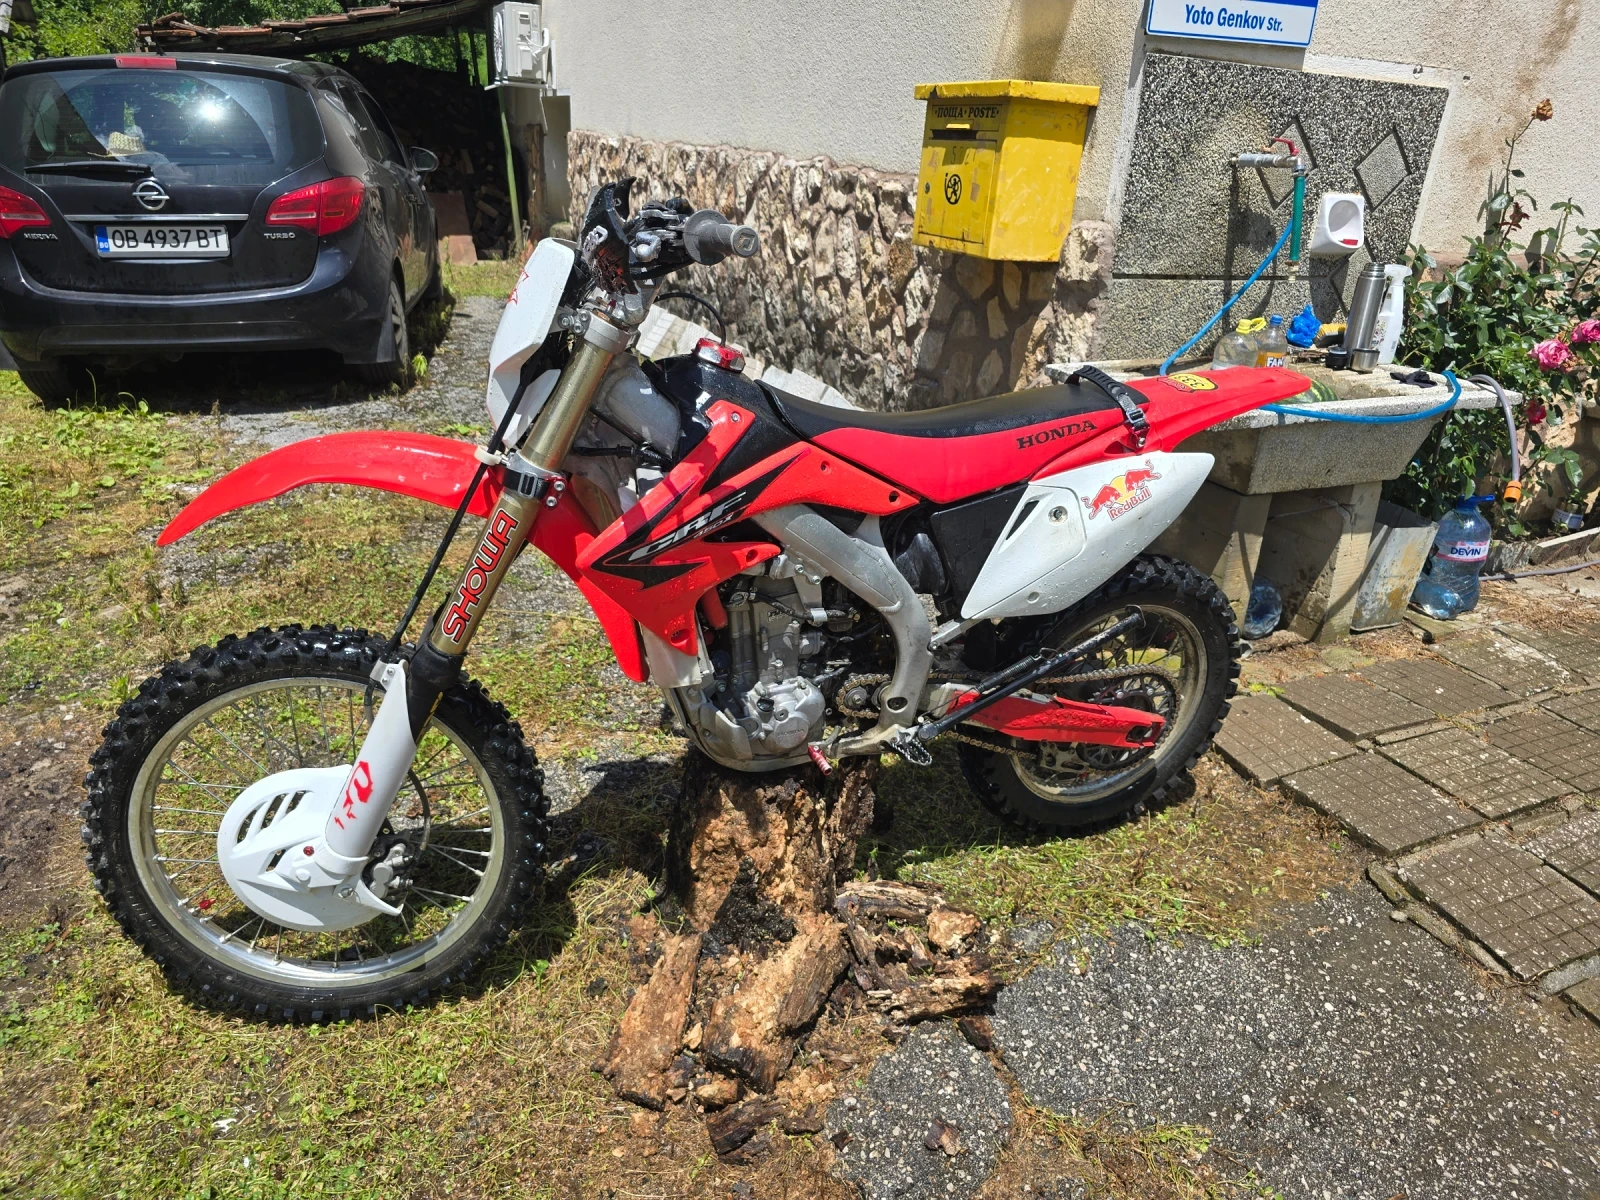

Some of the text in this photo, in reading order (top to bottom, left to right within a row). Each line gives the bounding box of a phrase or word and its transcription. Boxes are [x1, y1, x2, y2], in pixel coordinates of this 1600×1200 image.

[1185, 4, 1283, 32] Yoto Genkov Str.
[936, 106, 998, 119] ПОЩА POSTE
[23, 232, 59, 240] MERIVA
[112, 229, 222, 249] OB 4937 BT
[264, 232, 296, 240] TURBO
[1016, 419, 1098, 450] HONDA
[1109, 487, 1152, 520] Red Bull
[628, 490, 747, 561] CRF
[1450, 547, 1482, 557] DEVIN
[442, 508, 519, 643] SHOWA
